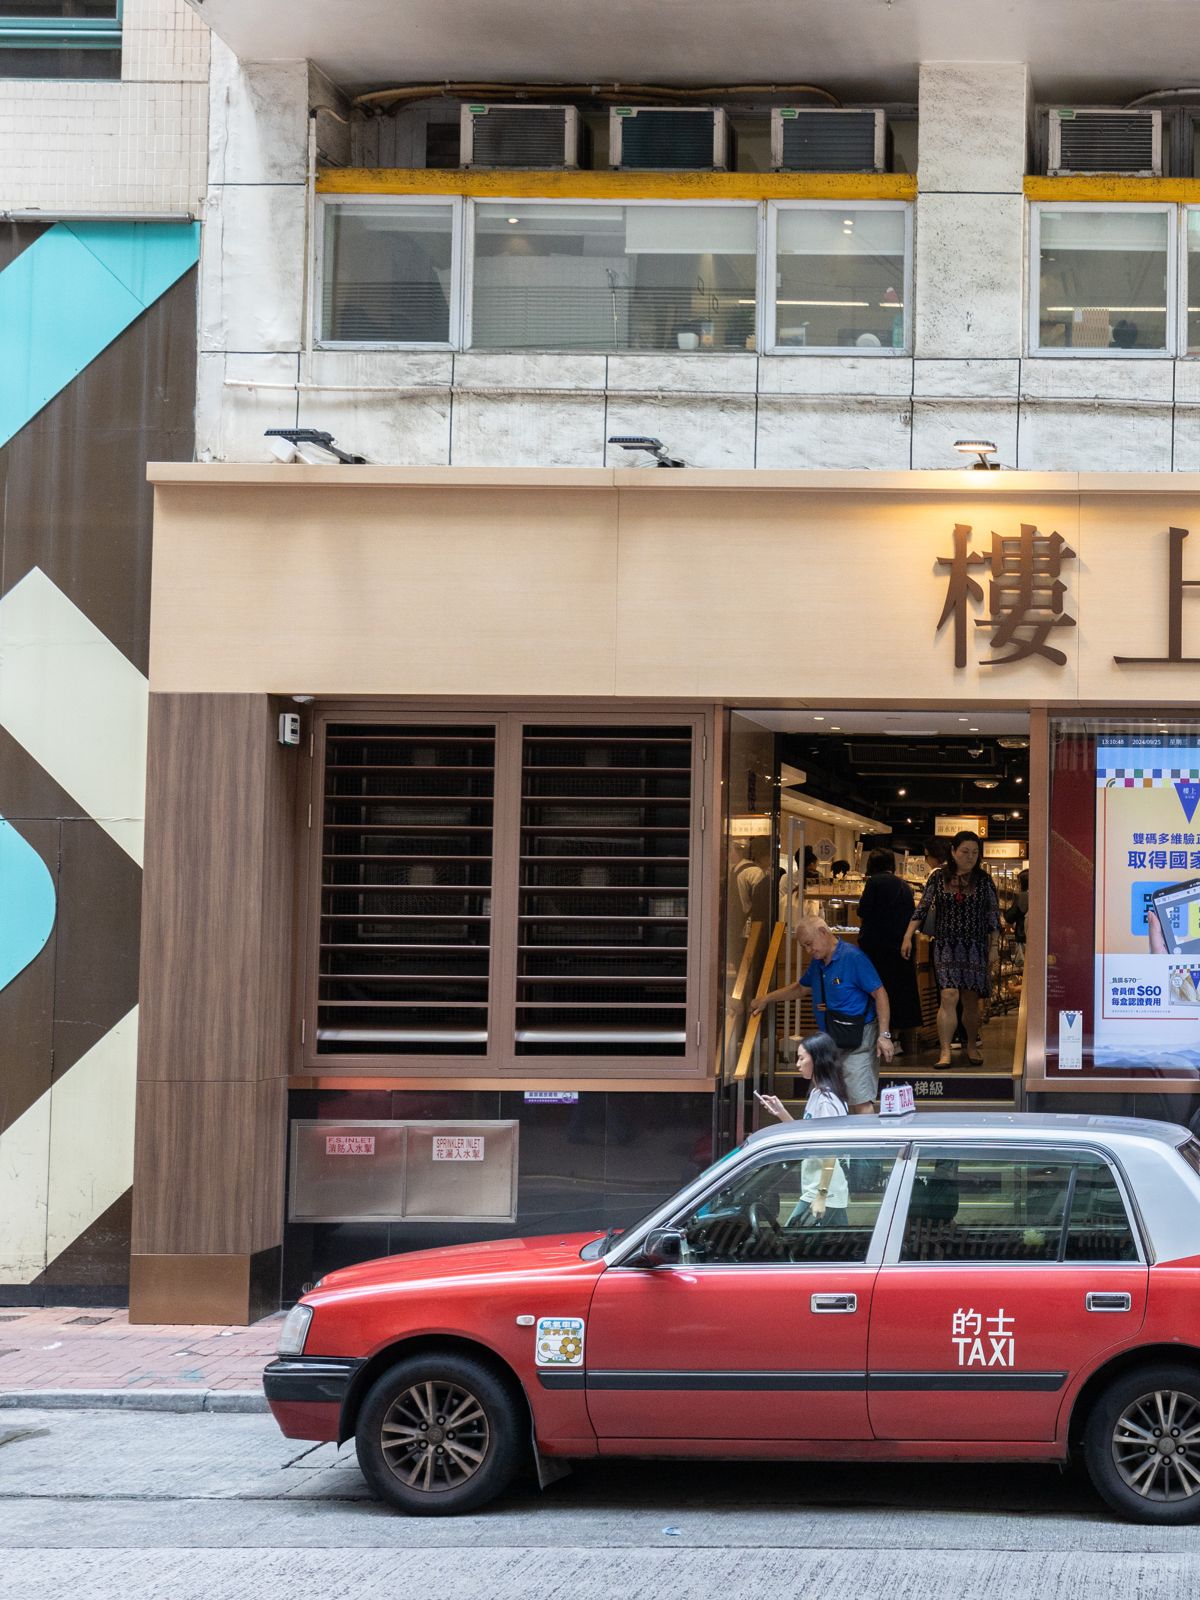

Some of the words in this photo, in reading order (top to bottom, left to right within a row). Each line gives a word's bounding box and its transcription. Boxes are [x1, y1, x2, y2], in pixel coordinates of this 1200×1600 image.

[980, 827, 986, 836] 3
[819, 845, 831, 854] 15
[1020, 849, 1025, 857] 2
[916, 864, 925, 872] 15
[1111, 987, 1136, 996] 會員價
[1137, 985, 1162, 997] $60
[1111, 997, 1161, 1007] 每盒認證費用
[884, 1094, 895, 1109] 的士
[436, 1138, 465, 1149] SPRINKLER
[466, 1138, 480, 1149] INLET
[952, 1308, 1015, 1337] 的士
[952, 1337, 1015, 1367] TAXI
